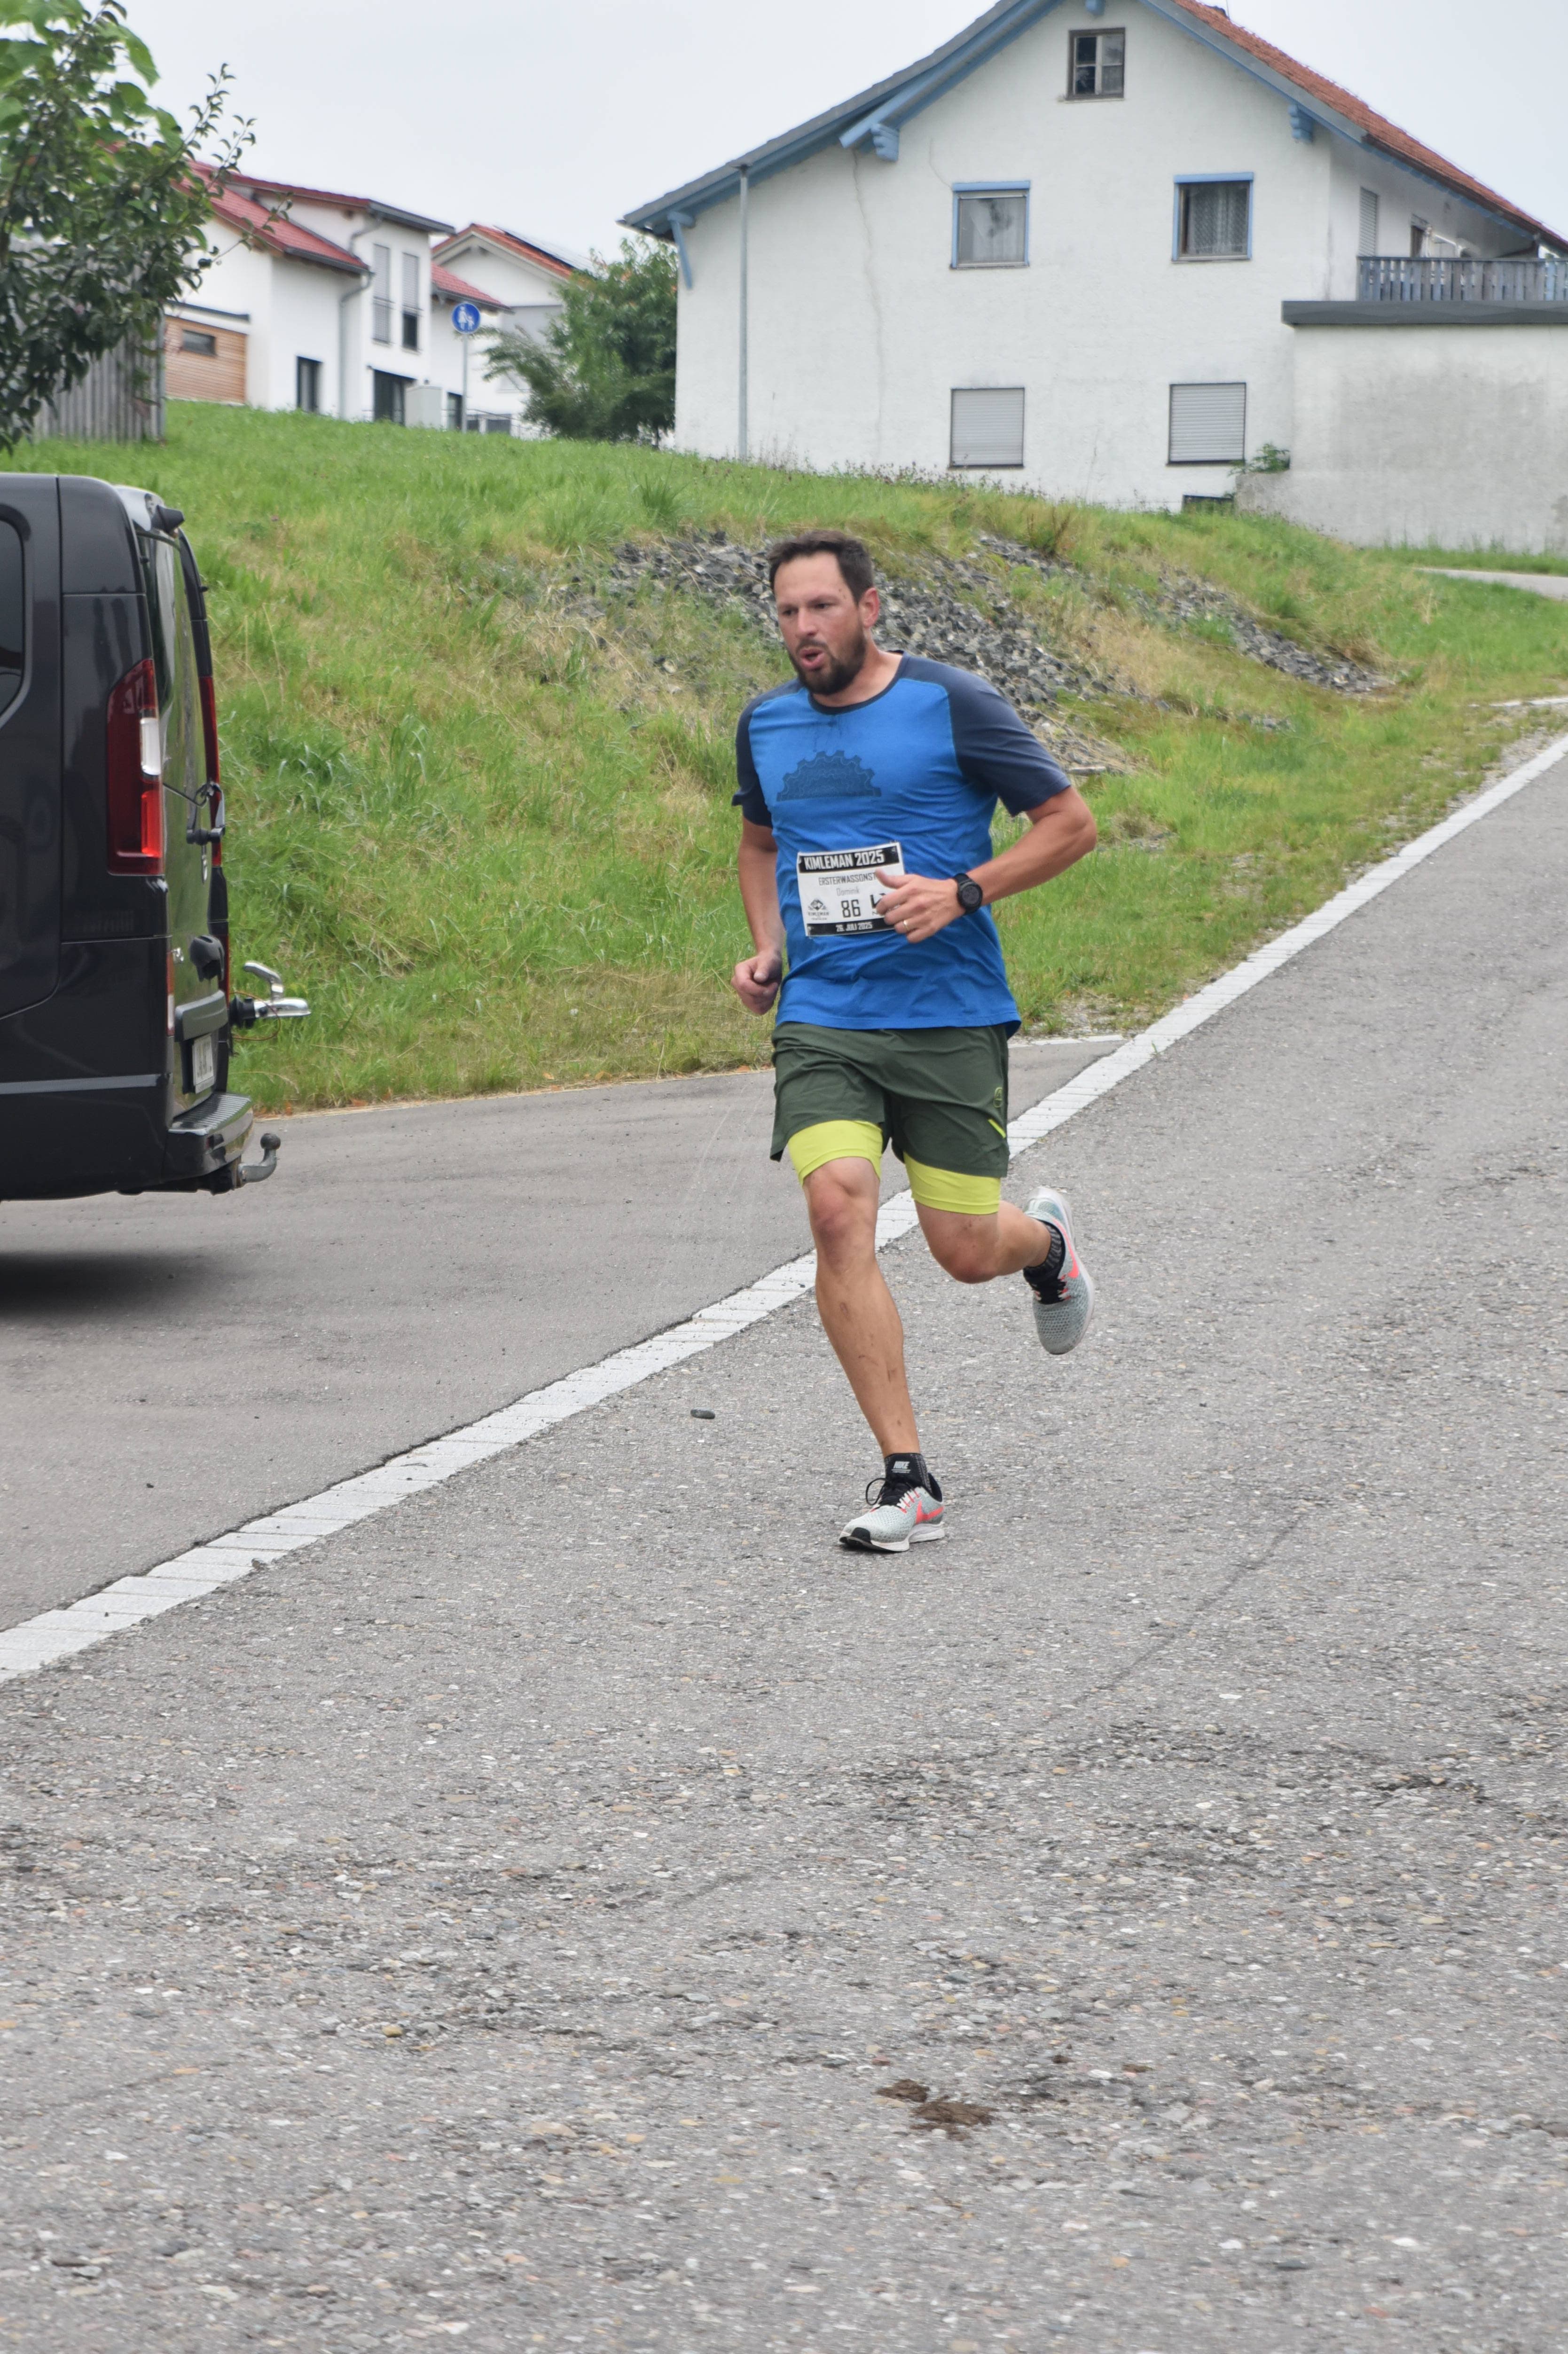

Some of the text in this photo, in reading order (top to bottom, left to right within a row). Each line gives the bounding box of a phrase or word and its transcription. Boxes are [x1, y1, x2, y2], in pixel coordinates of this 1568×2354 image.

[804, 849, 885, 870] KIMLEMAN 2025
[836, 886, 860, 896] Dominik
[841, 899, 861, 918] 86
[846, 923, 857, 931] JULI
[857, 922, 873, 930] 2025
[893, 1461, 910, 1469] NIKE
